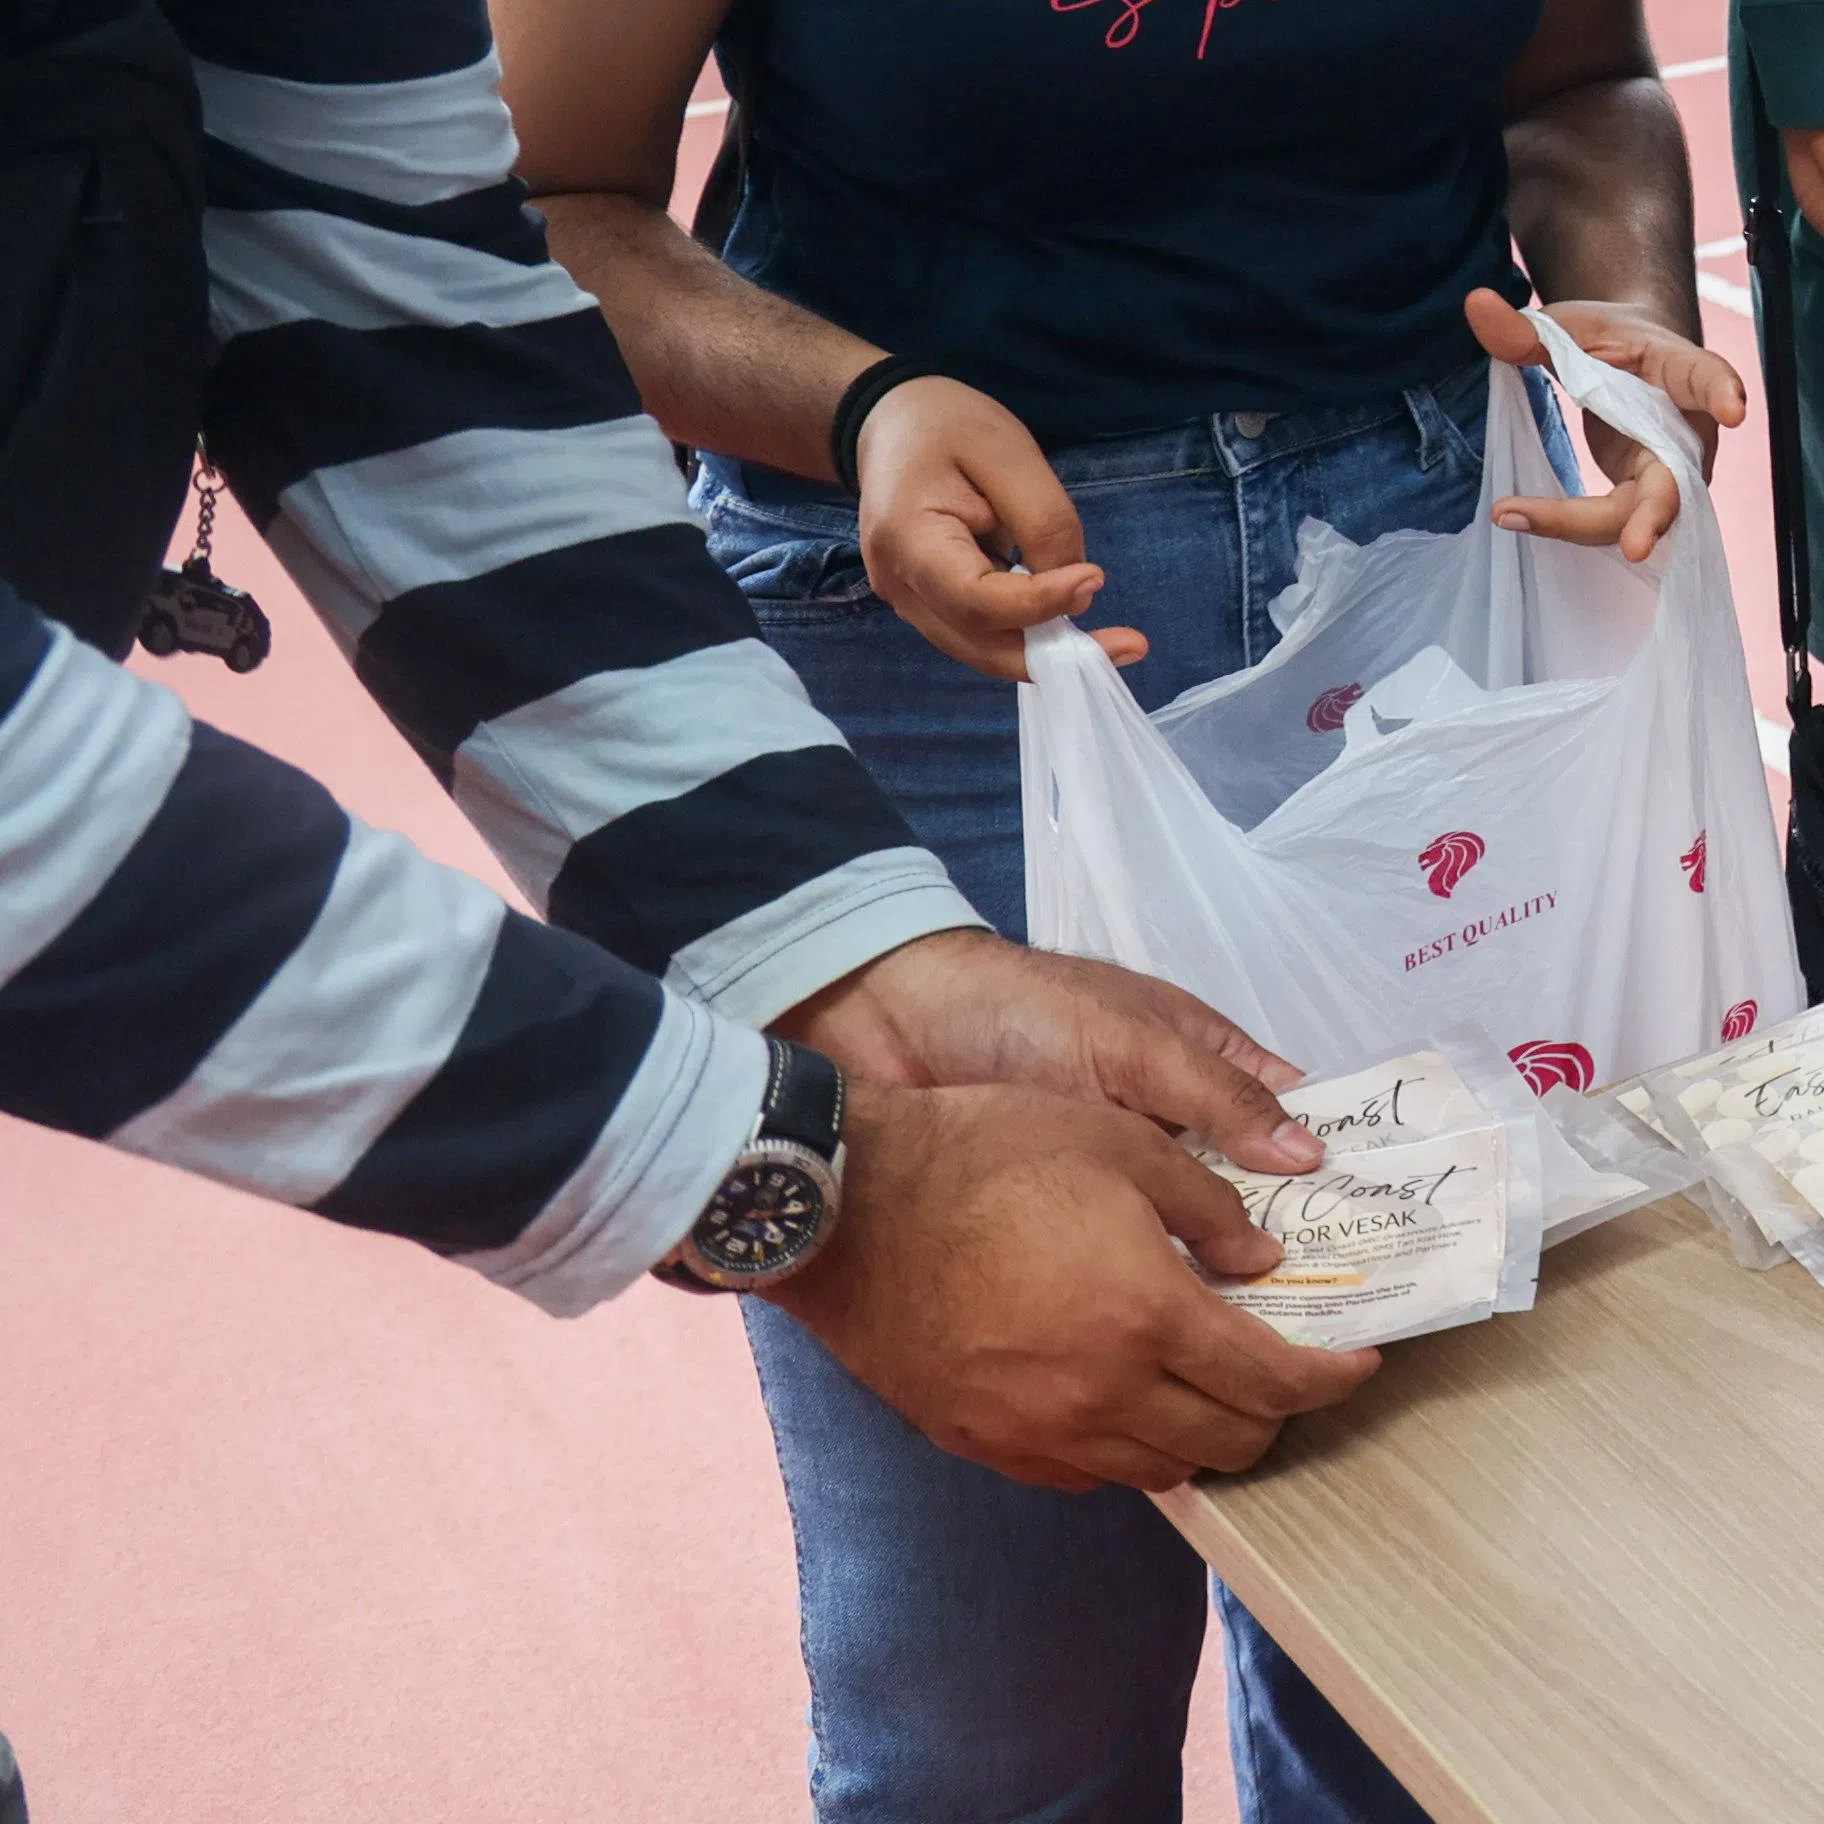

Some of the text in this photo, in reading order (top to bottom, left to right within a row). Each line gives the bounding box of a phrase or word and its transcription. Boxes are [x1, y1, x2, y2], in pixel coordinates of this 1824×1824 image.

[1404, 891, 1559, 972] BEST QUALITY
[1302, 1164, 1479, 1223] Coast
[1281, 1208, 1418, 1246] FOR VESAK
[1247, 1292, 1298, 1302] Singapore
[1375, 1285, 1391, 1296] the
[1270, 1276, 1338, 1286] Do you know?
[1268, 1300, 1286, 1310] and
